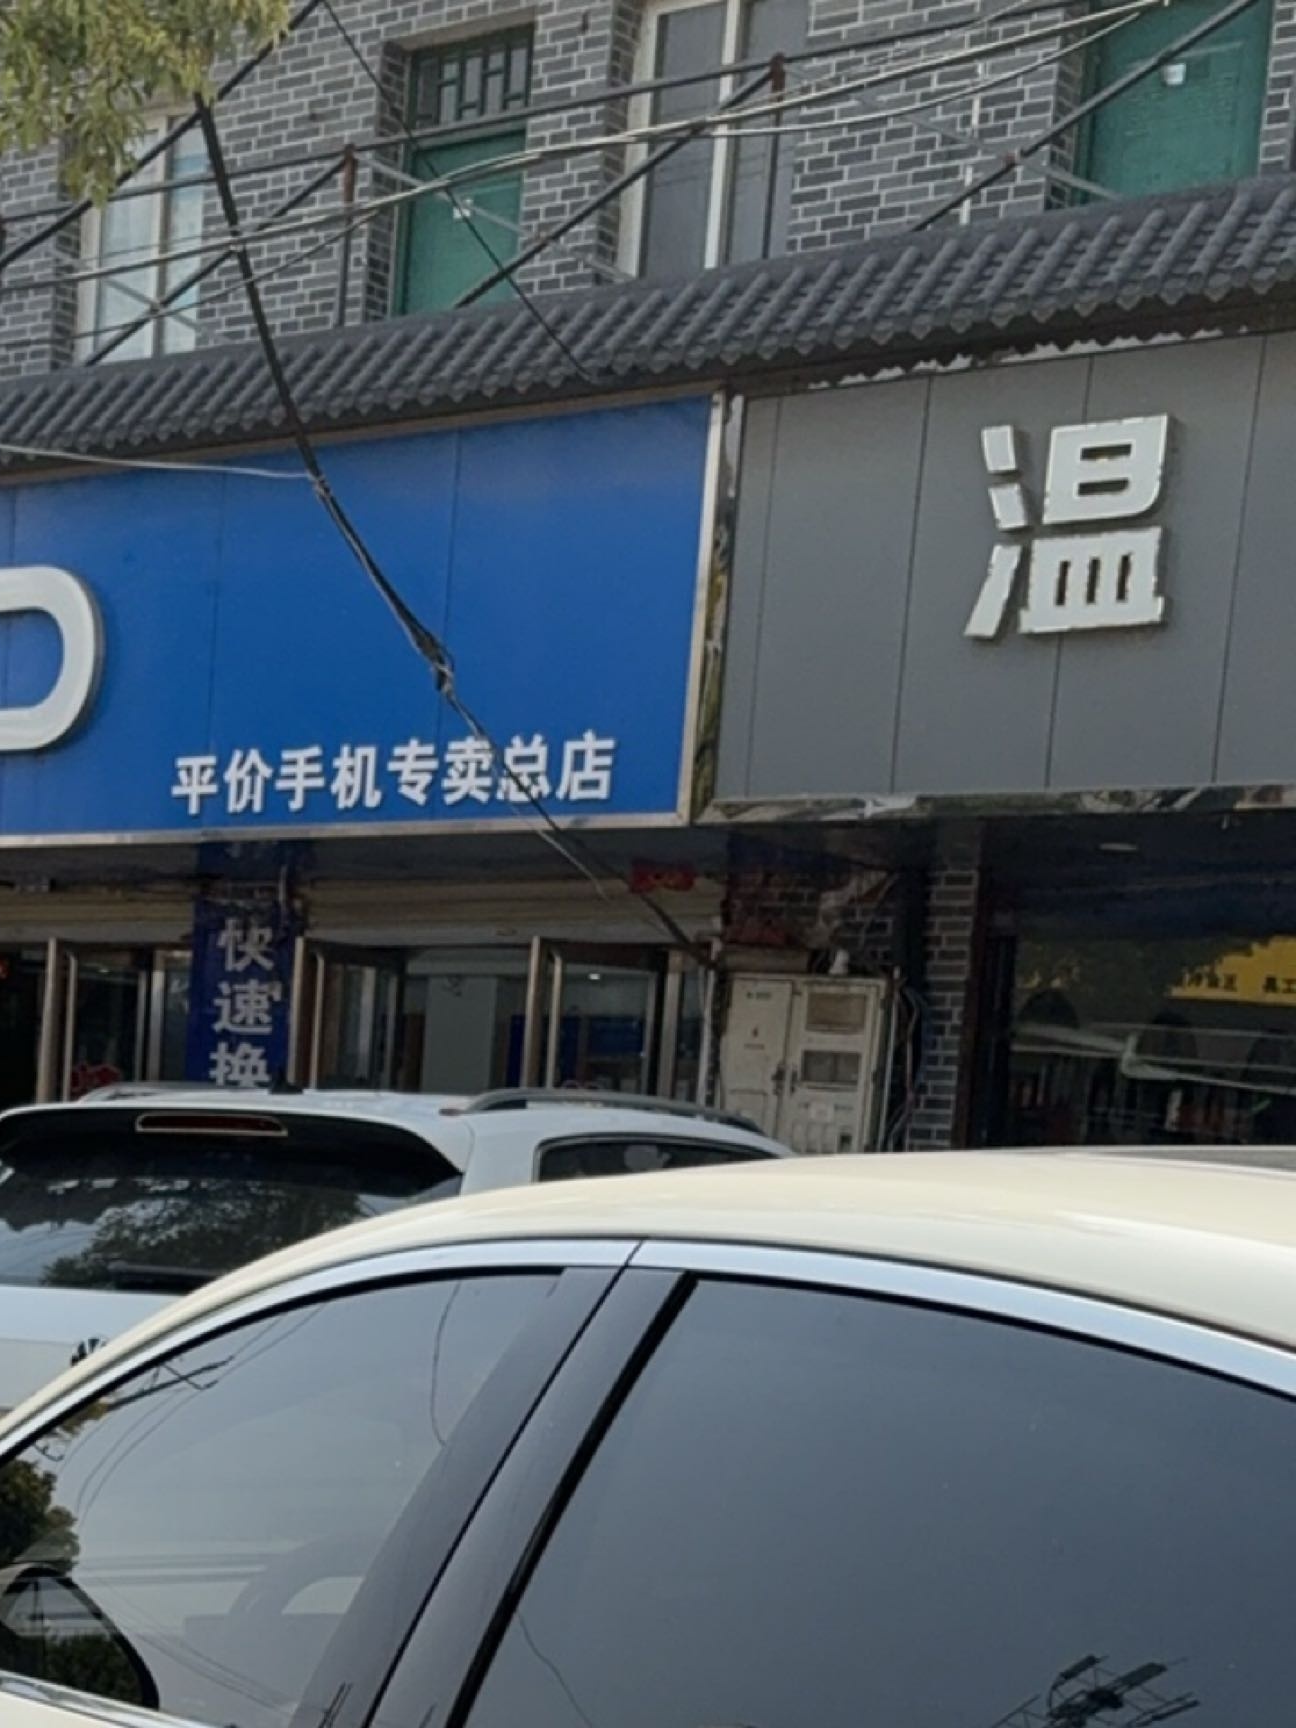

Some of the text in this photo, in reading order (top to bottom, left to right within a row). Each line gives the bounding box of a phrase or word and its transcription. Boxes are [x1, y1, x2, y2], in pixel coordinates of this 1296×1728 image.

[964, 415, 1168, 639] 温
[171, 728, 616, 816] 平价手机专卖总店
[209, 917, 278, 1088] 快速换
